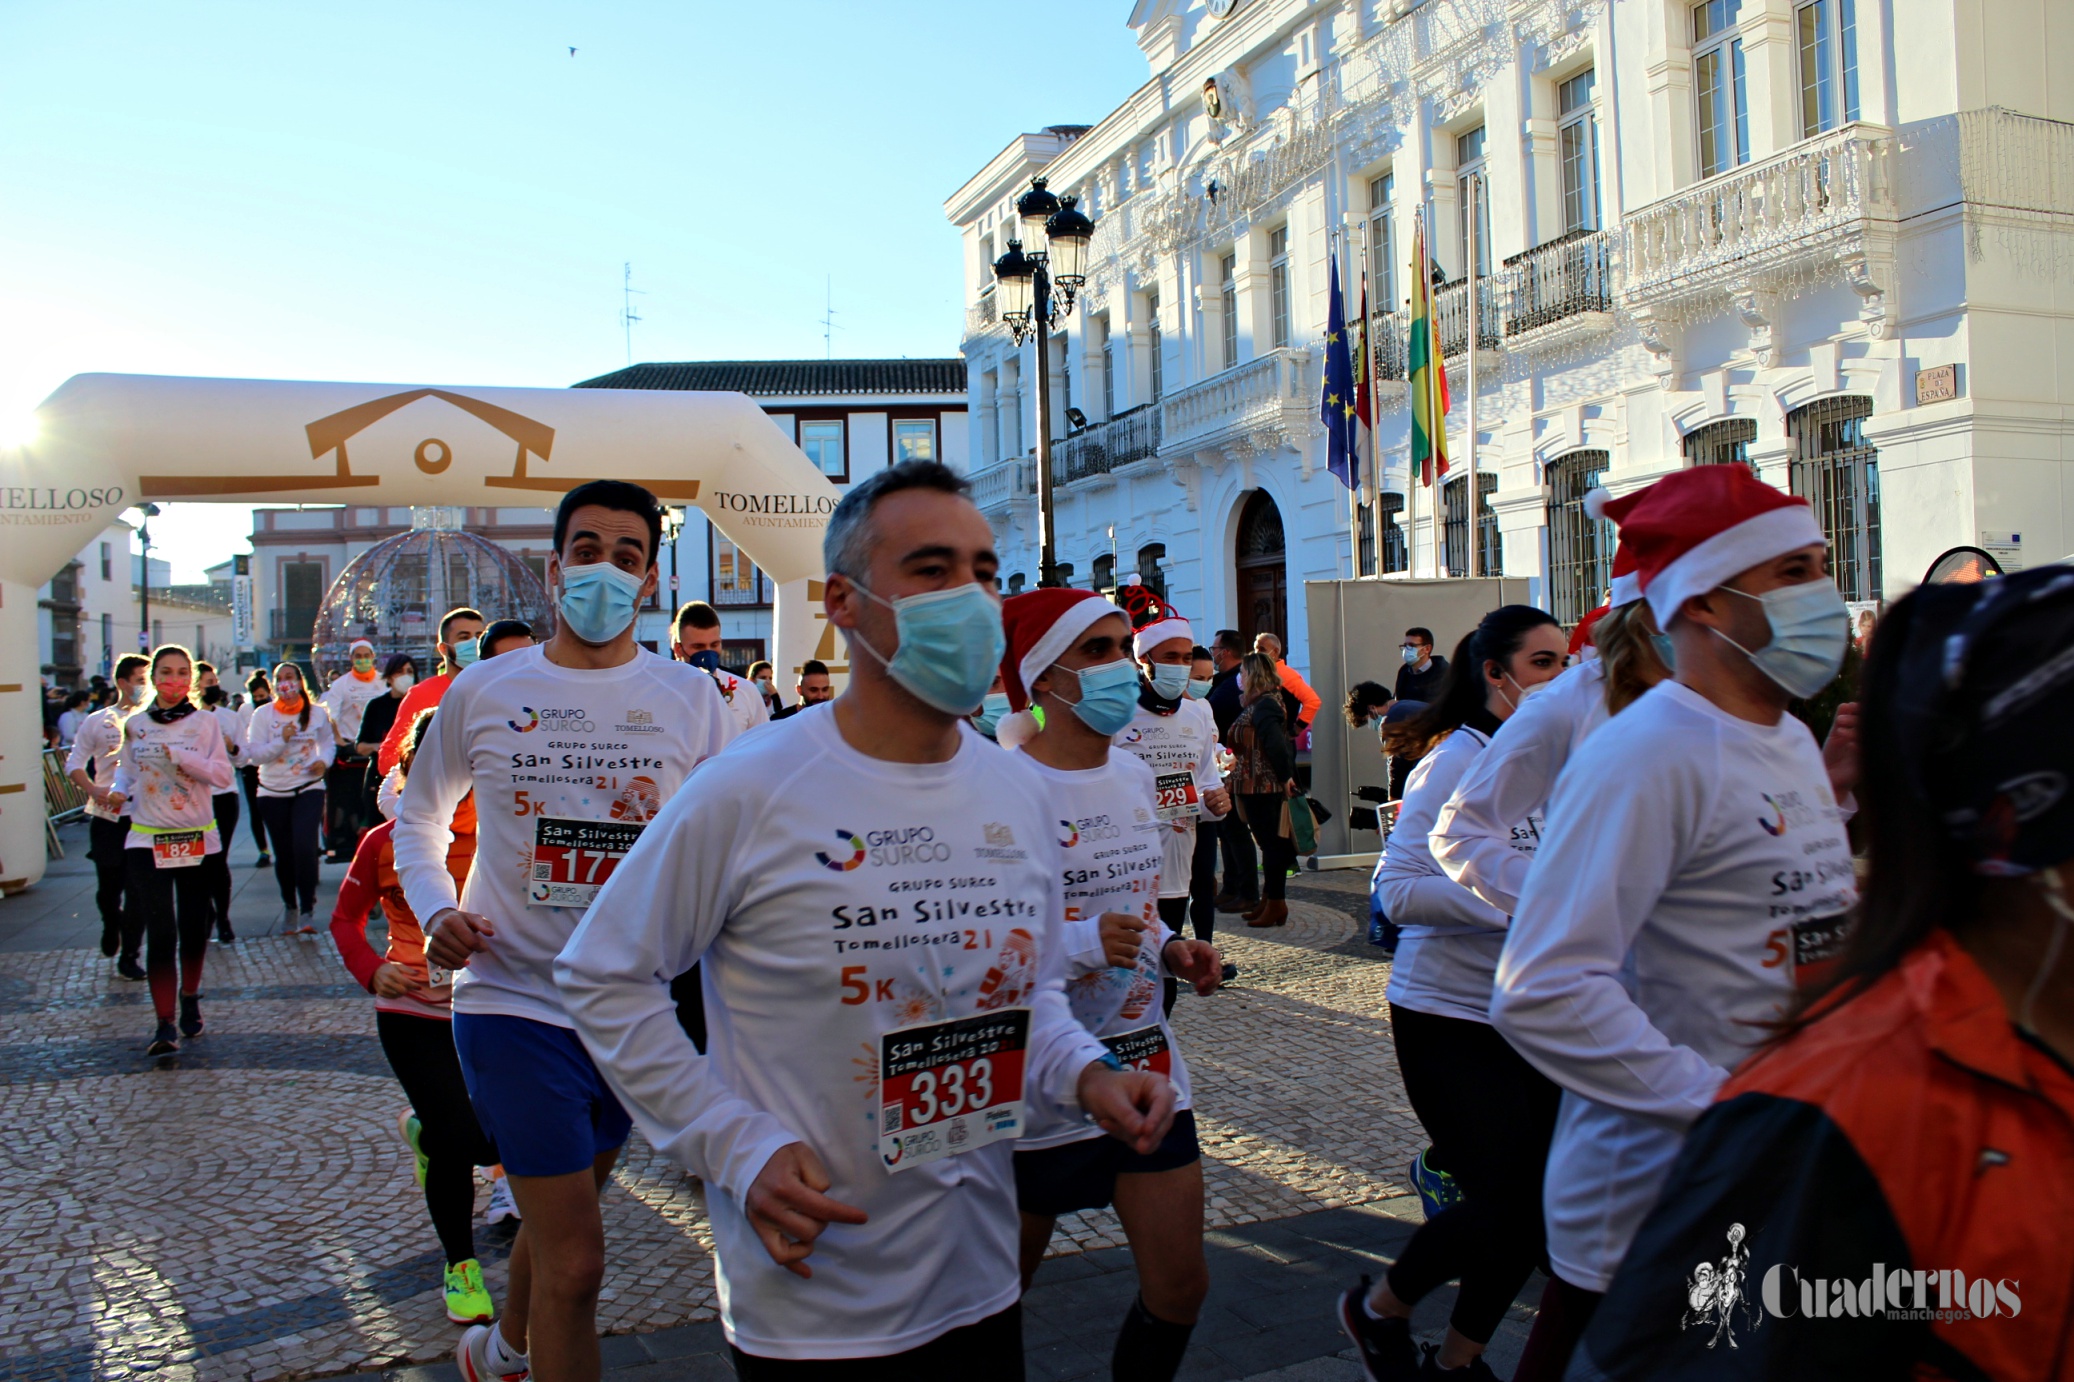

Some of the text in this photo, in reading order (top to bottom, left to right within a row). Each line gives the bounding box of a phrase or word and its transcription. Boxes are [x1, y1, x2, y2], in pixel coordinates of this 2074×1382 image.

[1928, 370, 1949, 380] PLAZA
[1921, 387, 1949, 401] ESPAÑA
[540, 709, 585, 720] GRUPO
[540, 720, 596, 733] SURCO
[615, 725, 665, 734] TOMELLOSO
[1142, 727, 1165, 735] GRUPO
[1143, 733, 1170, 741] SURCO
[548, 741, 629, 751] GRUPO SURCO
[511, 753, 664, 770] San Silvestre
[511, 774, 617, 790] Tomellosera 21
[1158, 777, 1189, 786] Silvestre
[1156, 788, 1187, 809] 229
[1076, 815, 1110, 830] GRUPO
[543, 826, 572, 836] San
[866, 826, 934, 847] GRUPO
[1080, 825, 1120, 843] SURCO
[170, 843, 191, 858] 82
[541, 837, 615, 849] Tomellosera
[870, 842, 951, 867] SURCO
[1093, 850, 1121, 860] GRUPO
[889, 877, 997, 893] GRUPO SURCO
[1063, 870, 1099, 886] San
[1771, 871, 1814, 896] San
[1063, 882, 1131, 900] Tomellosera
[832, 899, 1036, 930] San Silvestre
[833, 929, 992, 954] Tomellosera 21
[889, 1024, 1016, 1062] San Silvestre
[888, 1046, 976, 1076] Tomellosera
[908, 1058, 993, 1126] 333
